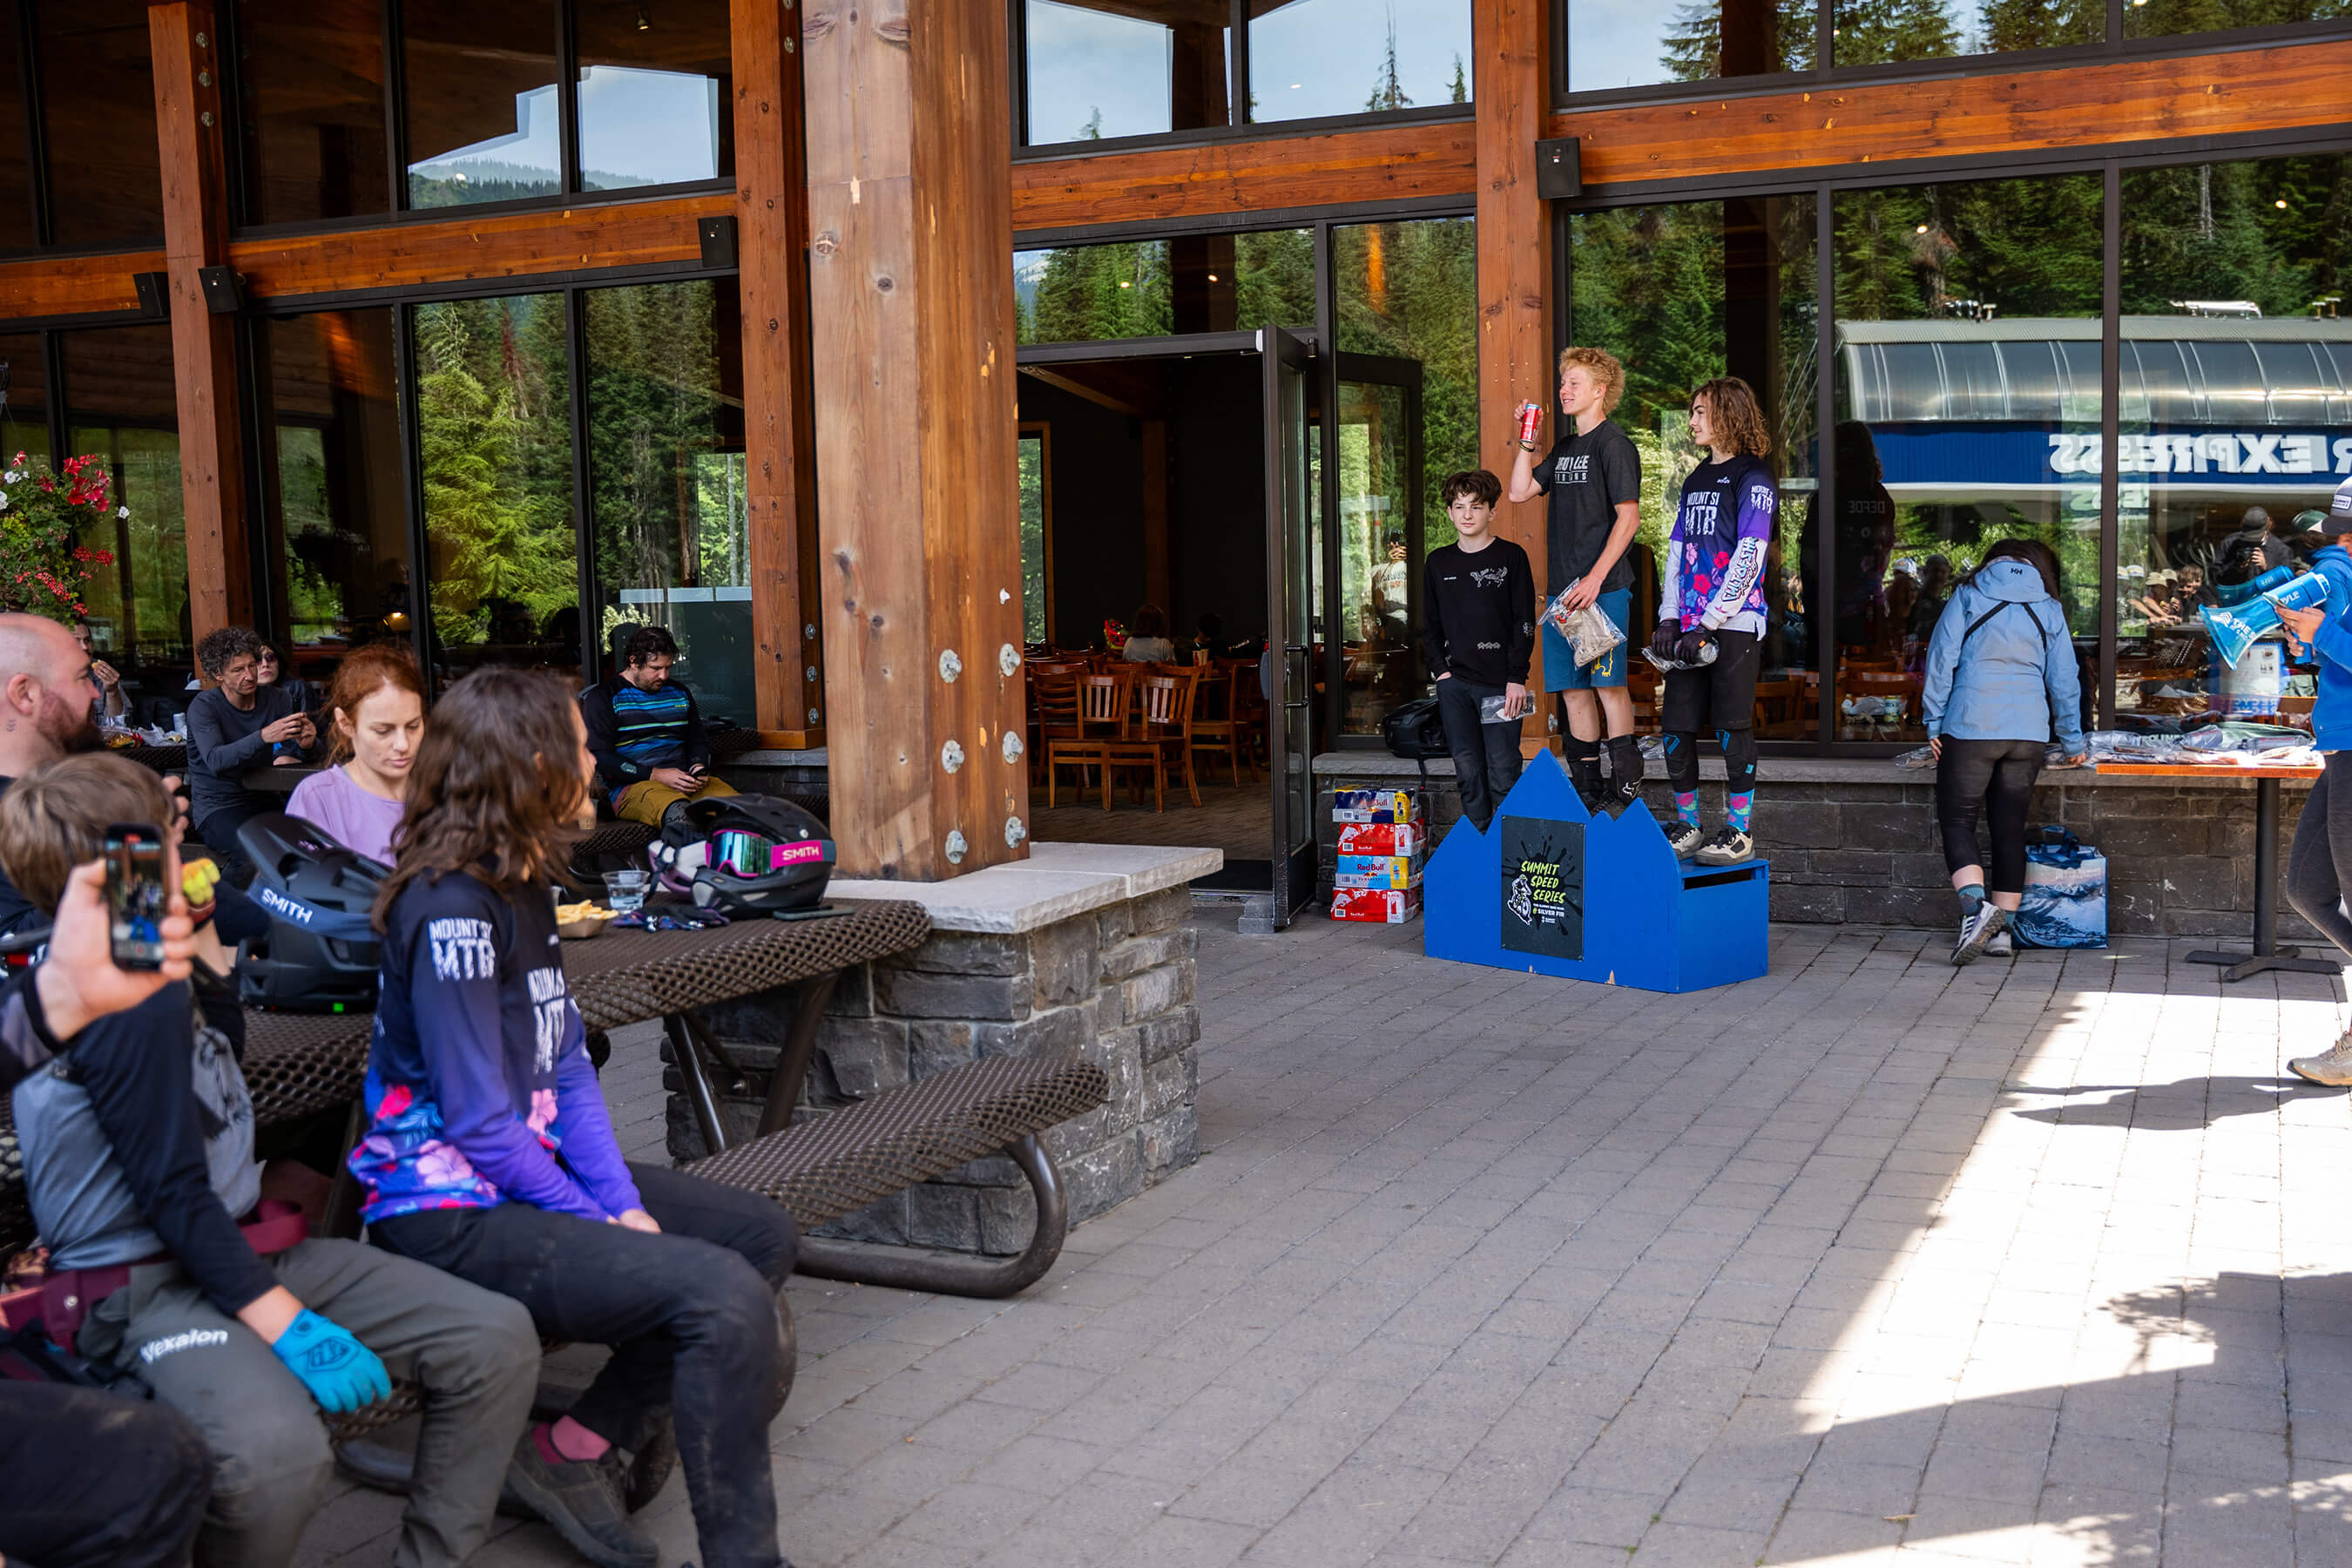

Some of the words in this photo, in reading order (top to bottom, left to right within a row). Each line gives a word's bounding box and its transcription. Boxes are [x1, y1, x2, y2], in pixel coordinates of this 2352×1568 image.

[1573, 455, 1590, 470] LEE
[1686, 491, 1711, 506] MOUNT
[1710, 492, 1720, 506] SI
[1685, 505, 1718, 537] MTB
[782, 846, 820, 861] SMITH
[1520, 860, 1560, 875] SUMMIT
[1530, 875, 1559, 889] SPEED
[1533, 889, 1566, 904] SERIES
[261, 887, 314, 924] SMITH
[1538, 908, 1556, 916] SILVER
[429, 917, 478, 941] MOUNT
